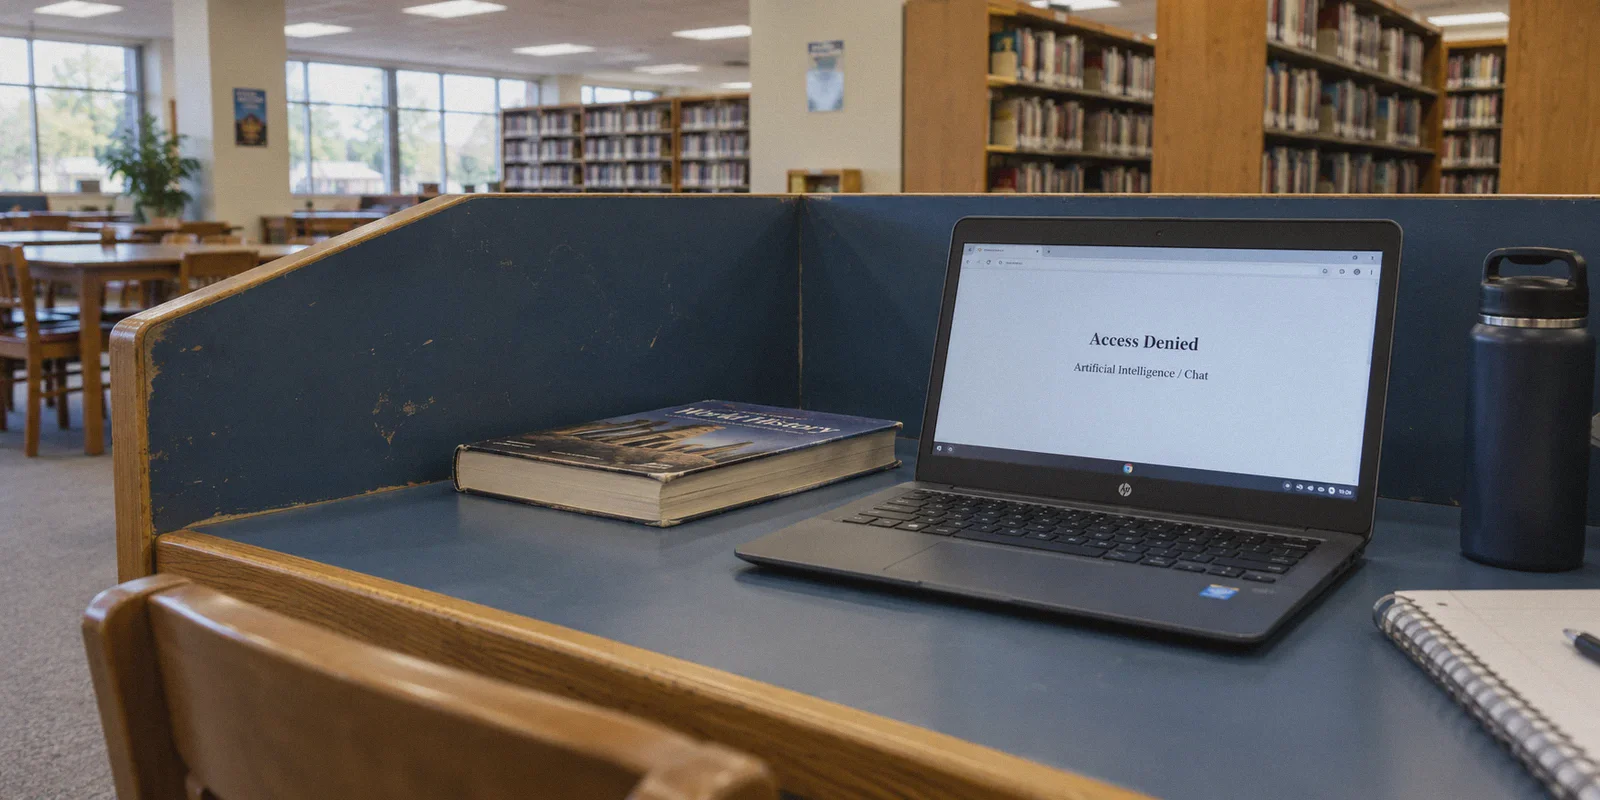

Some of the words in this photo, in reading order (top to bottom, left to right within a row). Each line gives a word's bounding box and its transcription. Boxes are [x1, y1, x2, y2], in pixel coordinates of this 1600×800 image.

[1089, 332, 1139, 348] Access
[1143, 335, 1199, 351] Denied
[1073, 362, 1116, 375] Artificial
[1118, 365, 1175, 379] Intelligence
[1184, 370, 1209, 381] Chat
[674, 408, 750, 421] World
[742, 417, 841, 434] History
